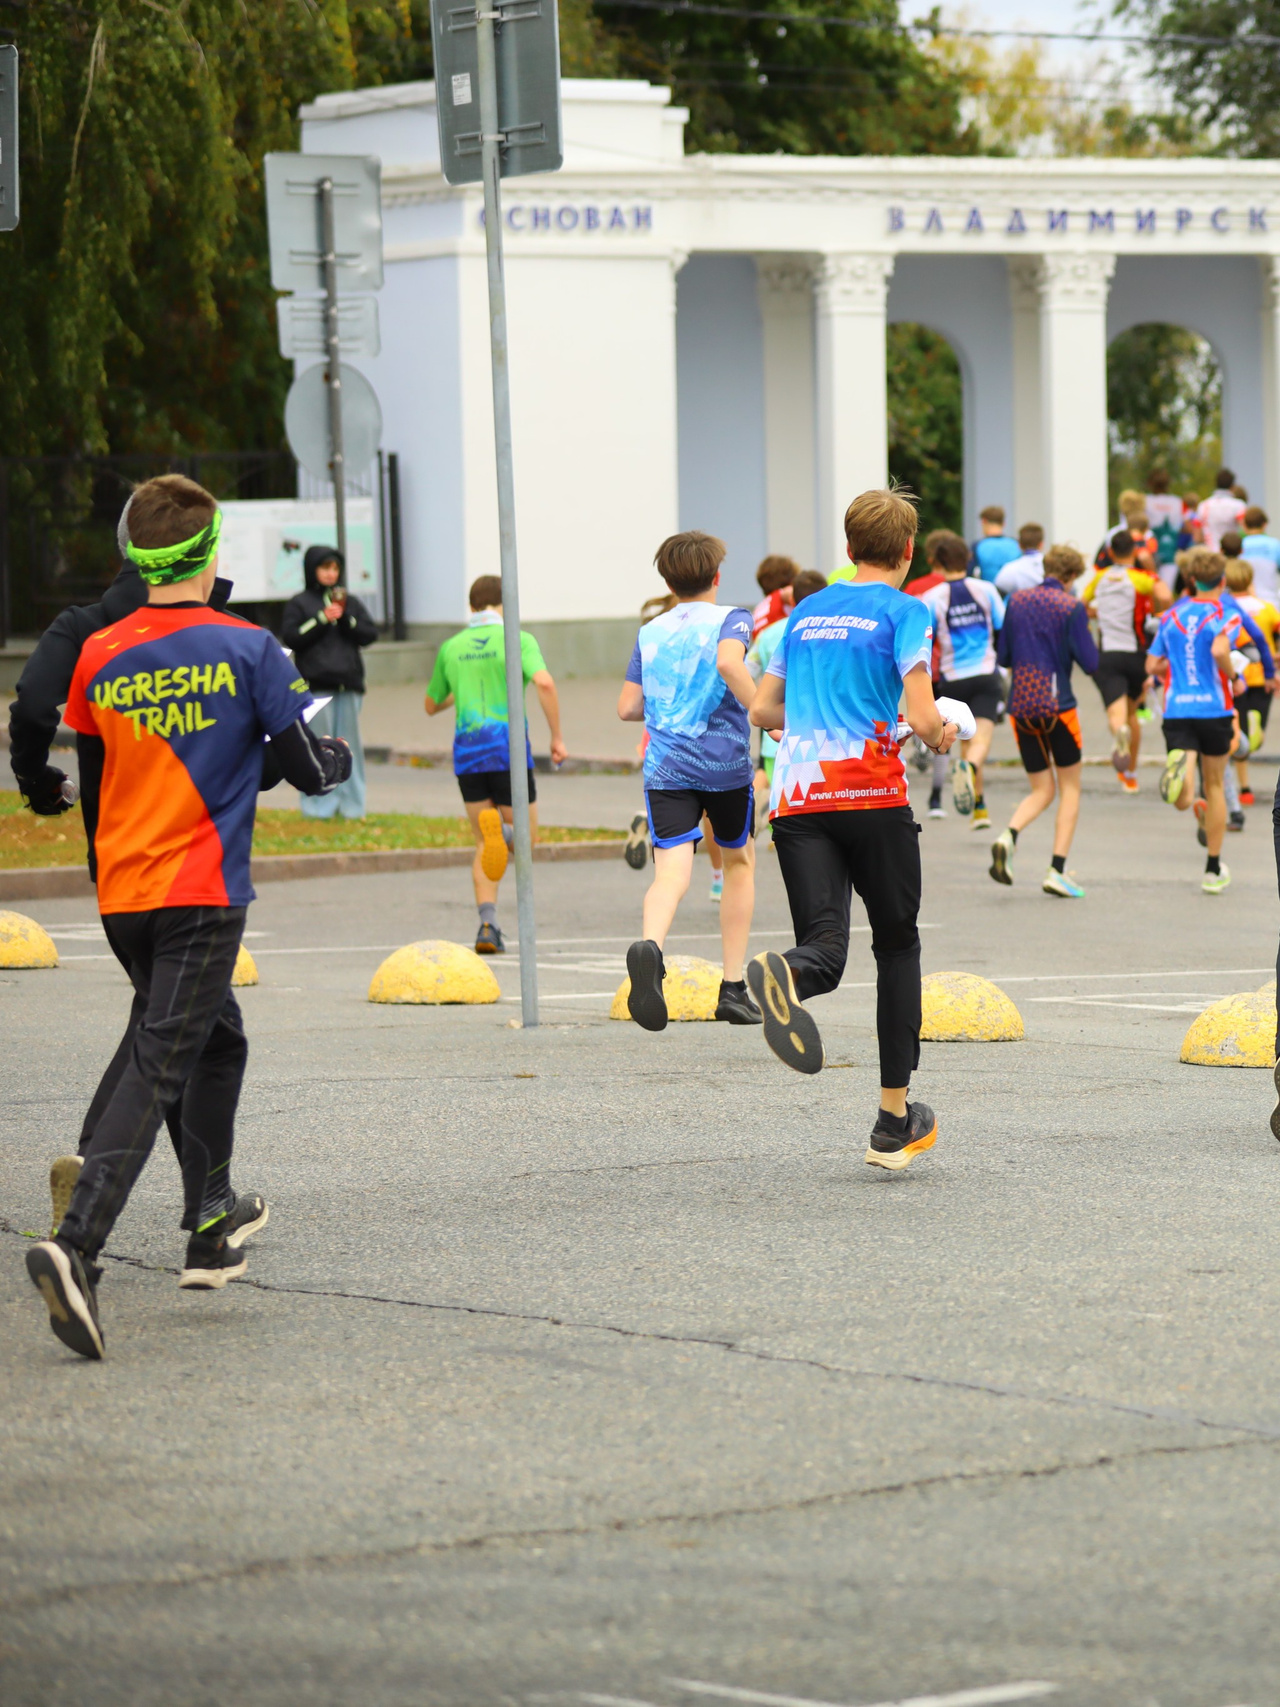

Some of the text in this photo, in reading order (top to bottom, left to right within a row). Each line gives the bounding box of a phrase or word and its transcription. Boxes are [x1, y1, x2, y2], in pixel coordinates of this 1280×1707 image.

[801, 627, 848, 641] ОБЛАСТЬ
[94, 661, 237, 710] UGRESHA
[123, 700, 218, 742] TRAIL
[809, 786, 899, 801] www.volgoorient.ru
